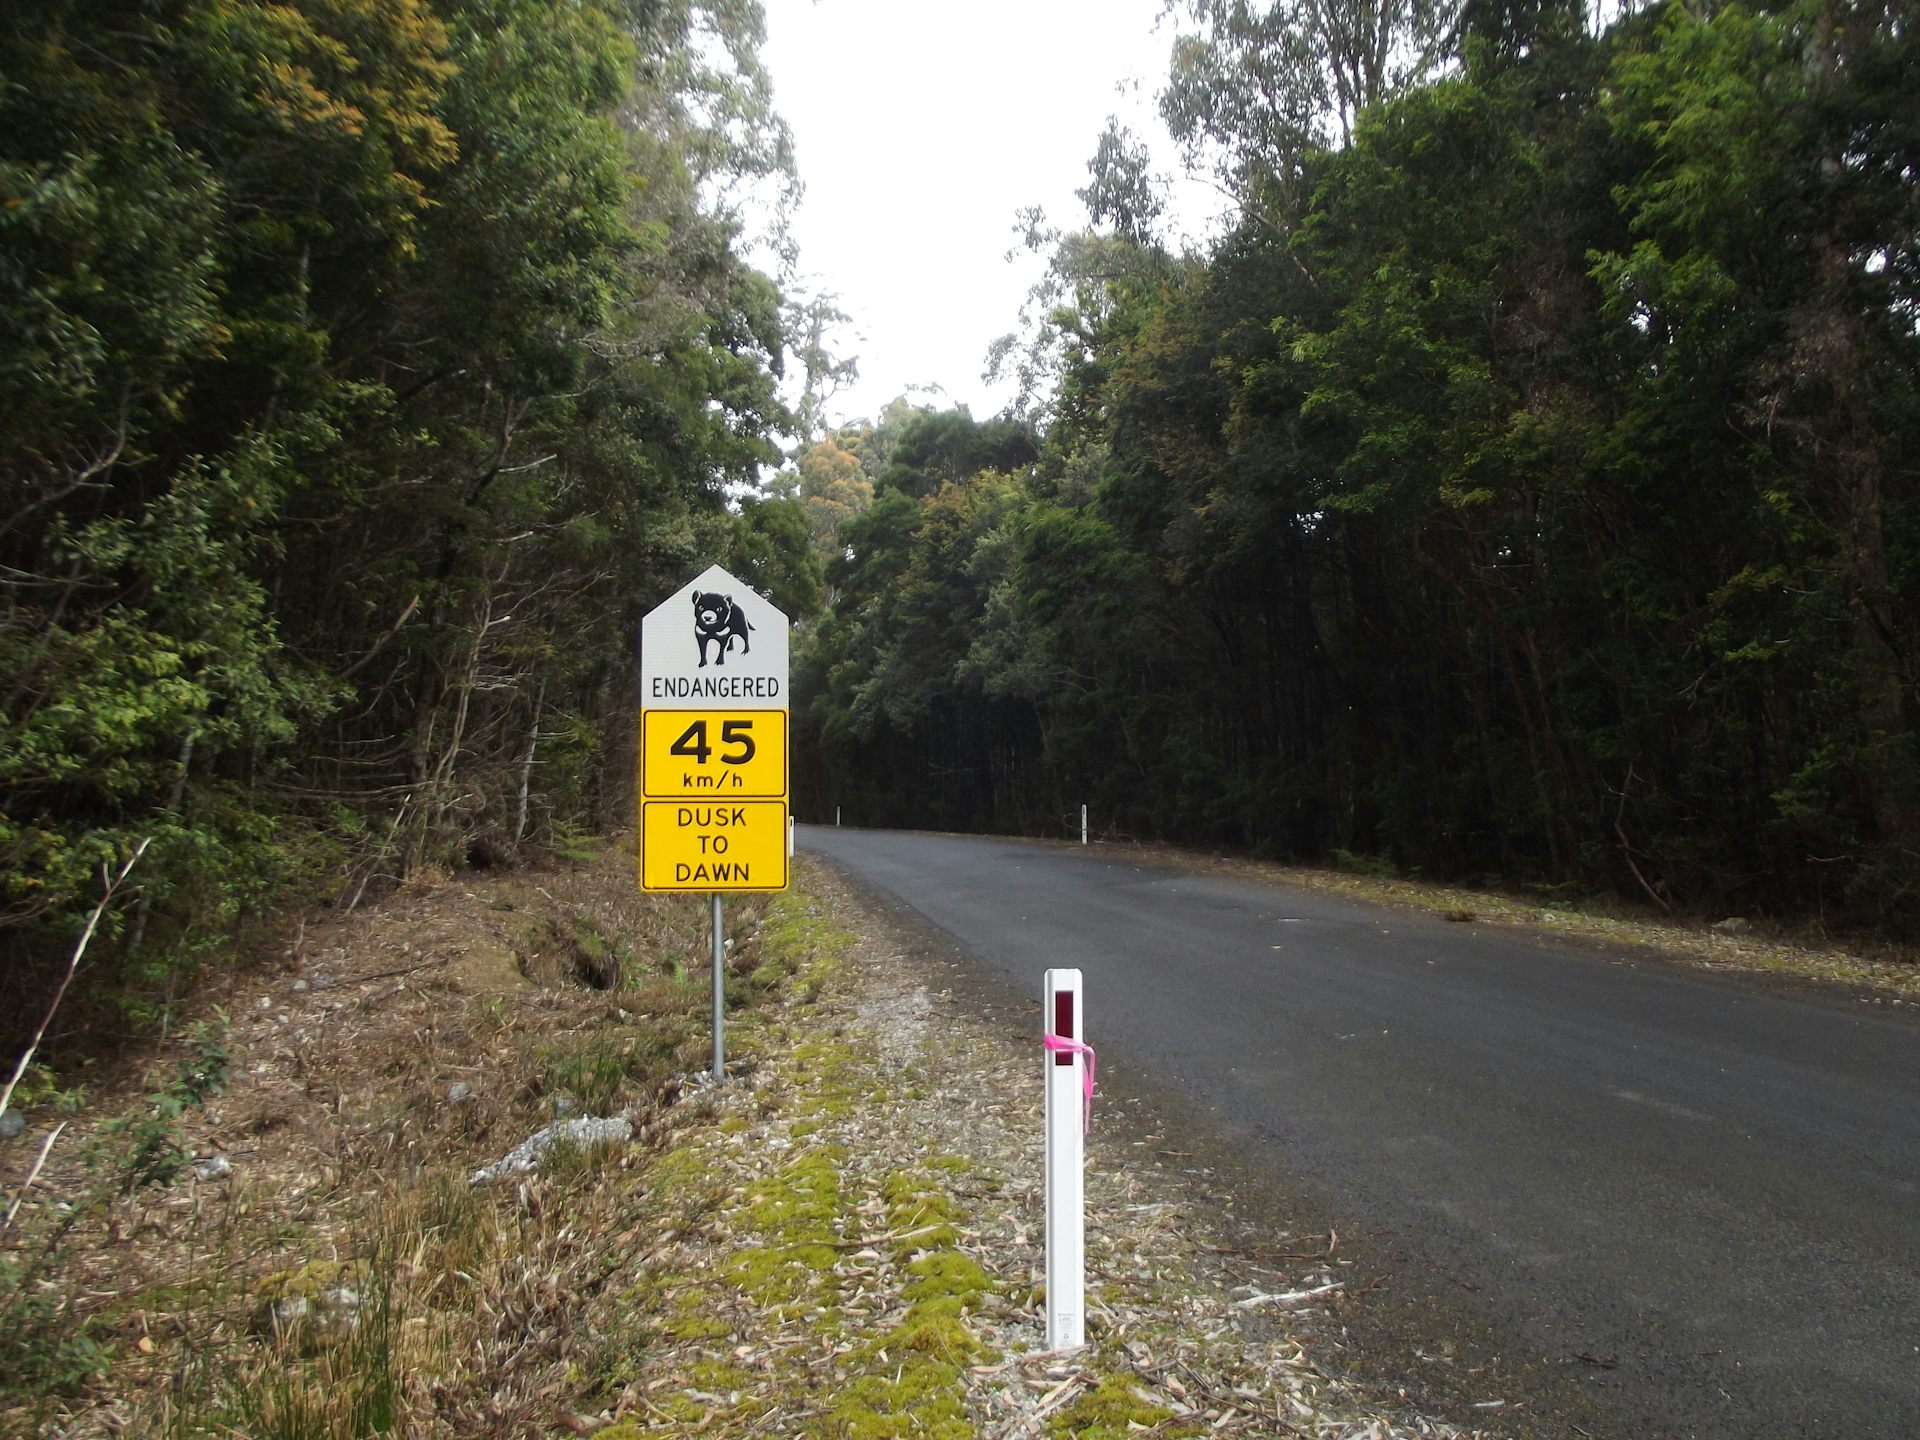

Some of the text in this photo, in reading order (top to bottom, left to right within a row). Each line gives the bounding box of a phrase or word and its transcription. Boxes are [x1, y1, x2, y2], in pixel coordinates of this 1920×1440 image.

[652, 677, 779, 697] ENDANGERED
[670, 720, 756, 764] 45
[683, 770, 743, 789] km/h
[677, 808, 747, 827] DUSK
[697, 835, 728, 854] TO
[676, 863, 750, 882] DAWN
